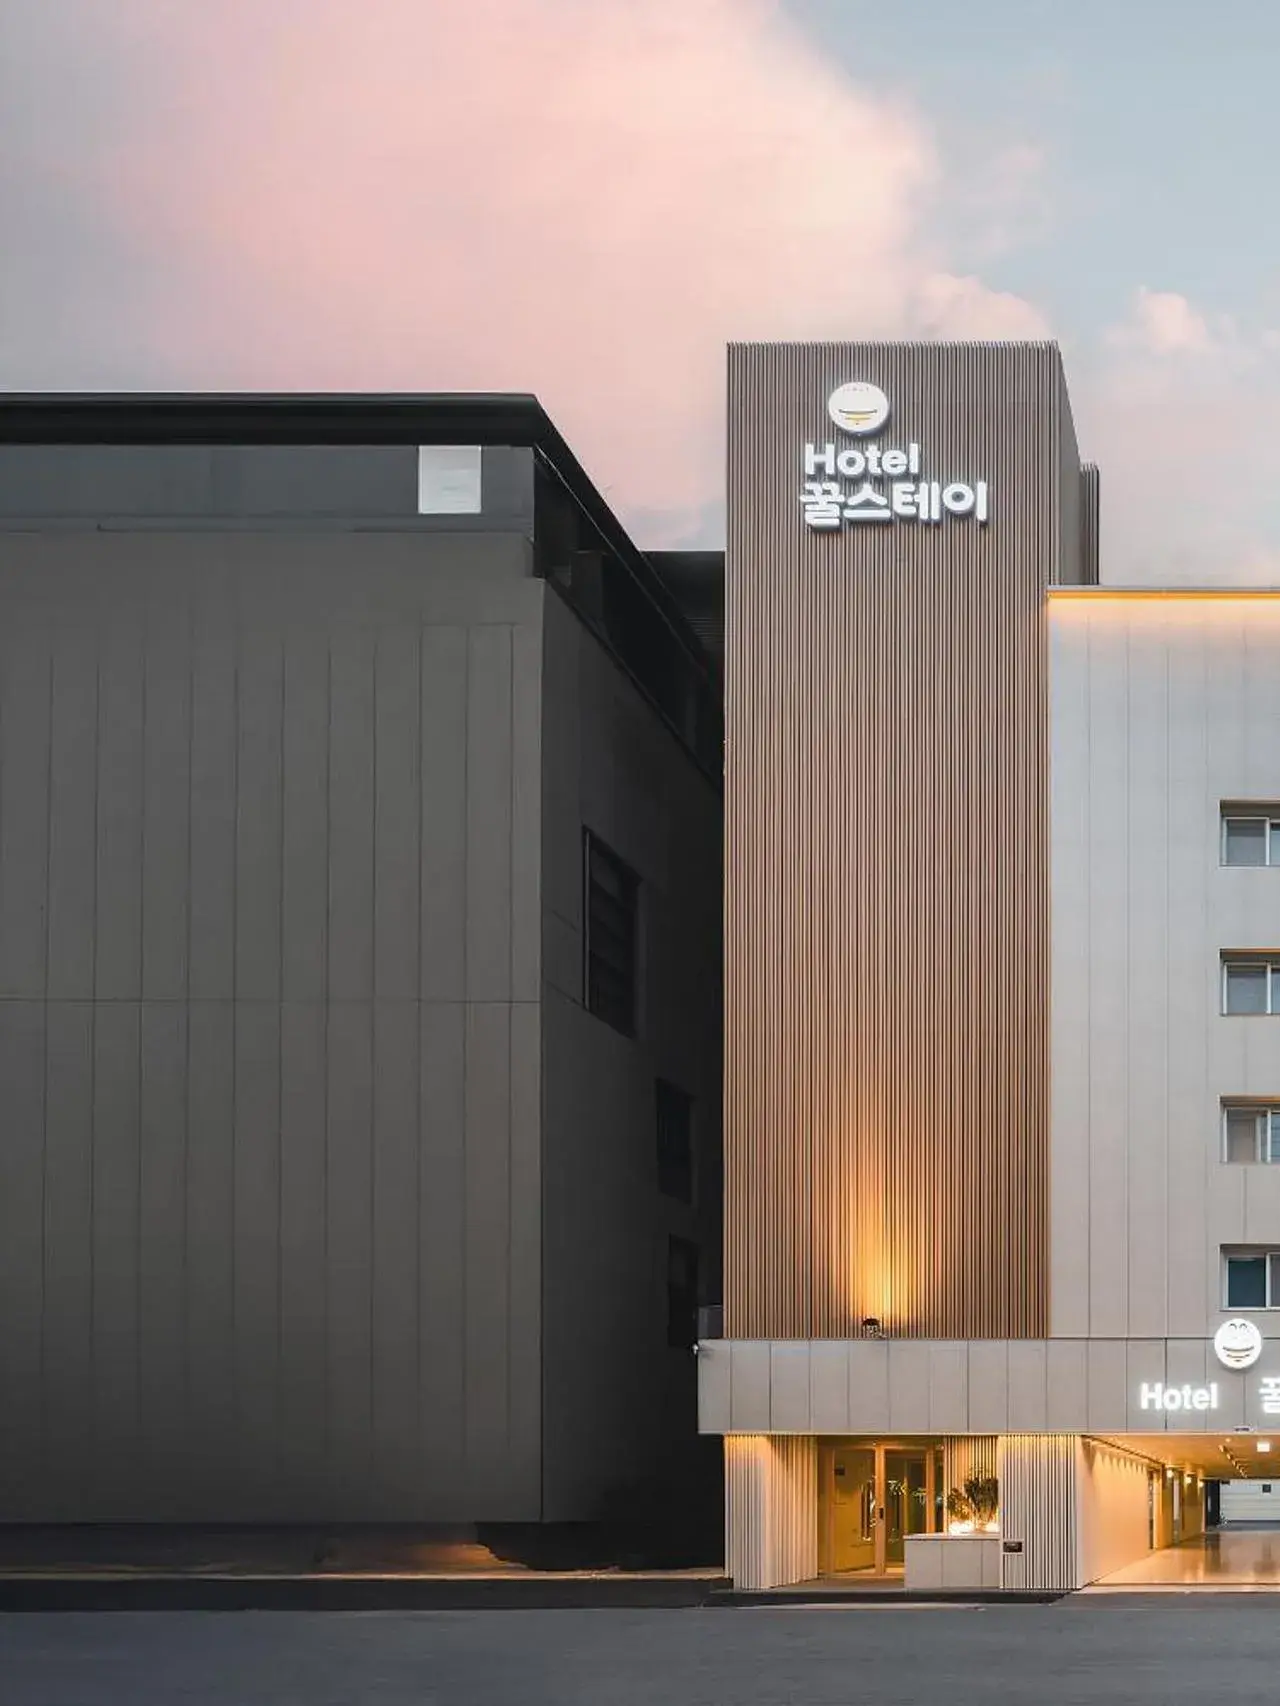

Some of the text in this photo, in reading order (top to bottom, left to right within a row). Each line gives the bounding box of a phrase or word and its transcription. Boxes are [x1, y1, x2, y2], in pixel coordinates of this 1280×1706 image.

[804, 442, 919, 475] Hotel
[799, 481, 987, 527] 꿀스테이
[1140, 1382, 1218, 1410] Hotel
